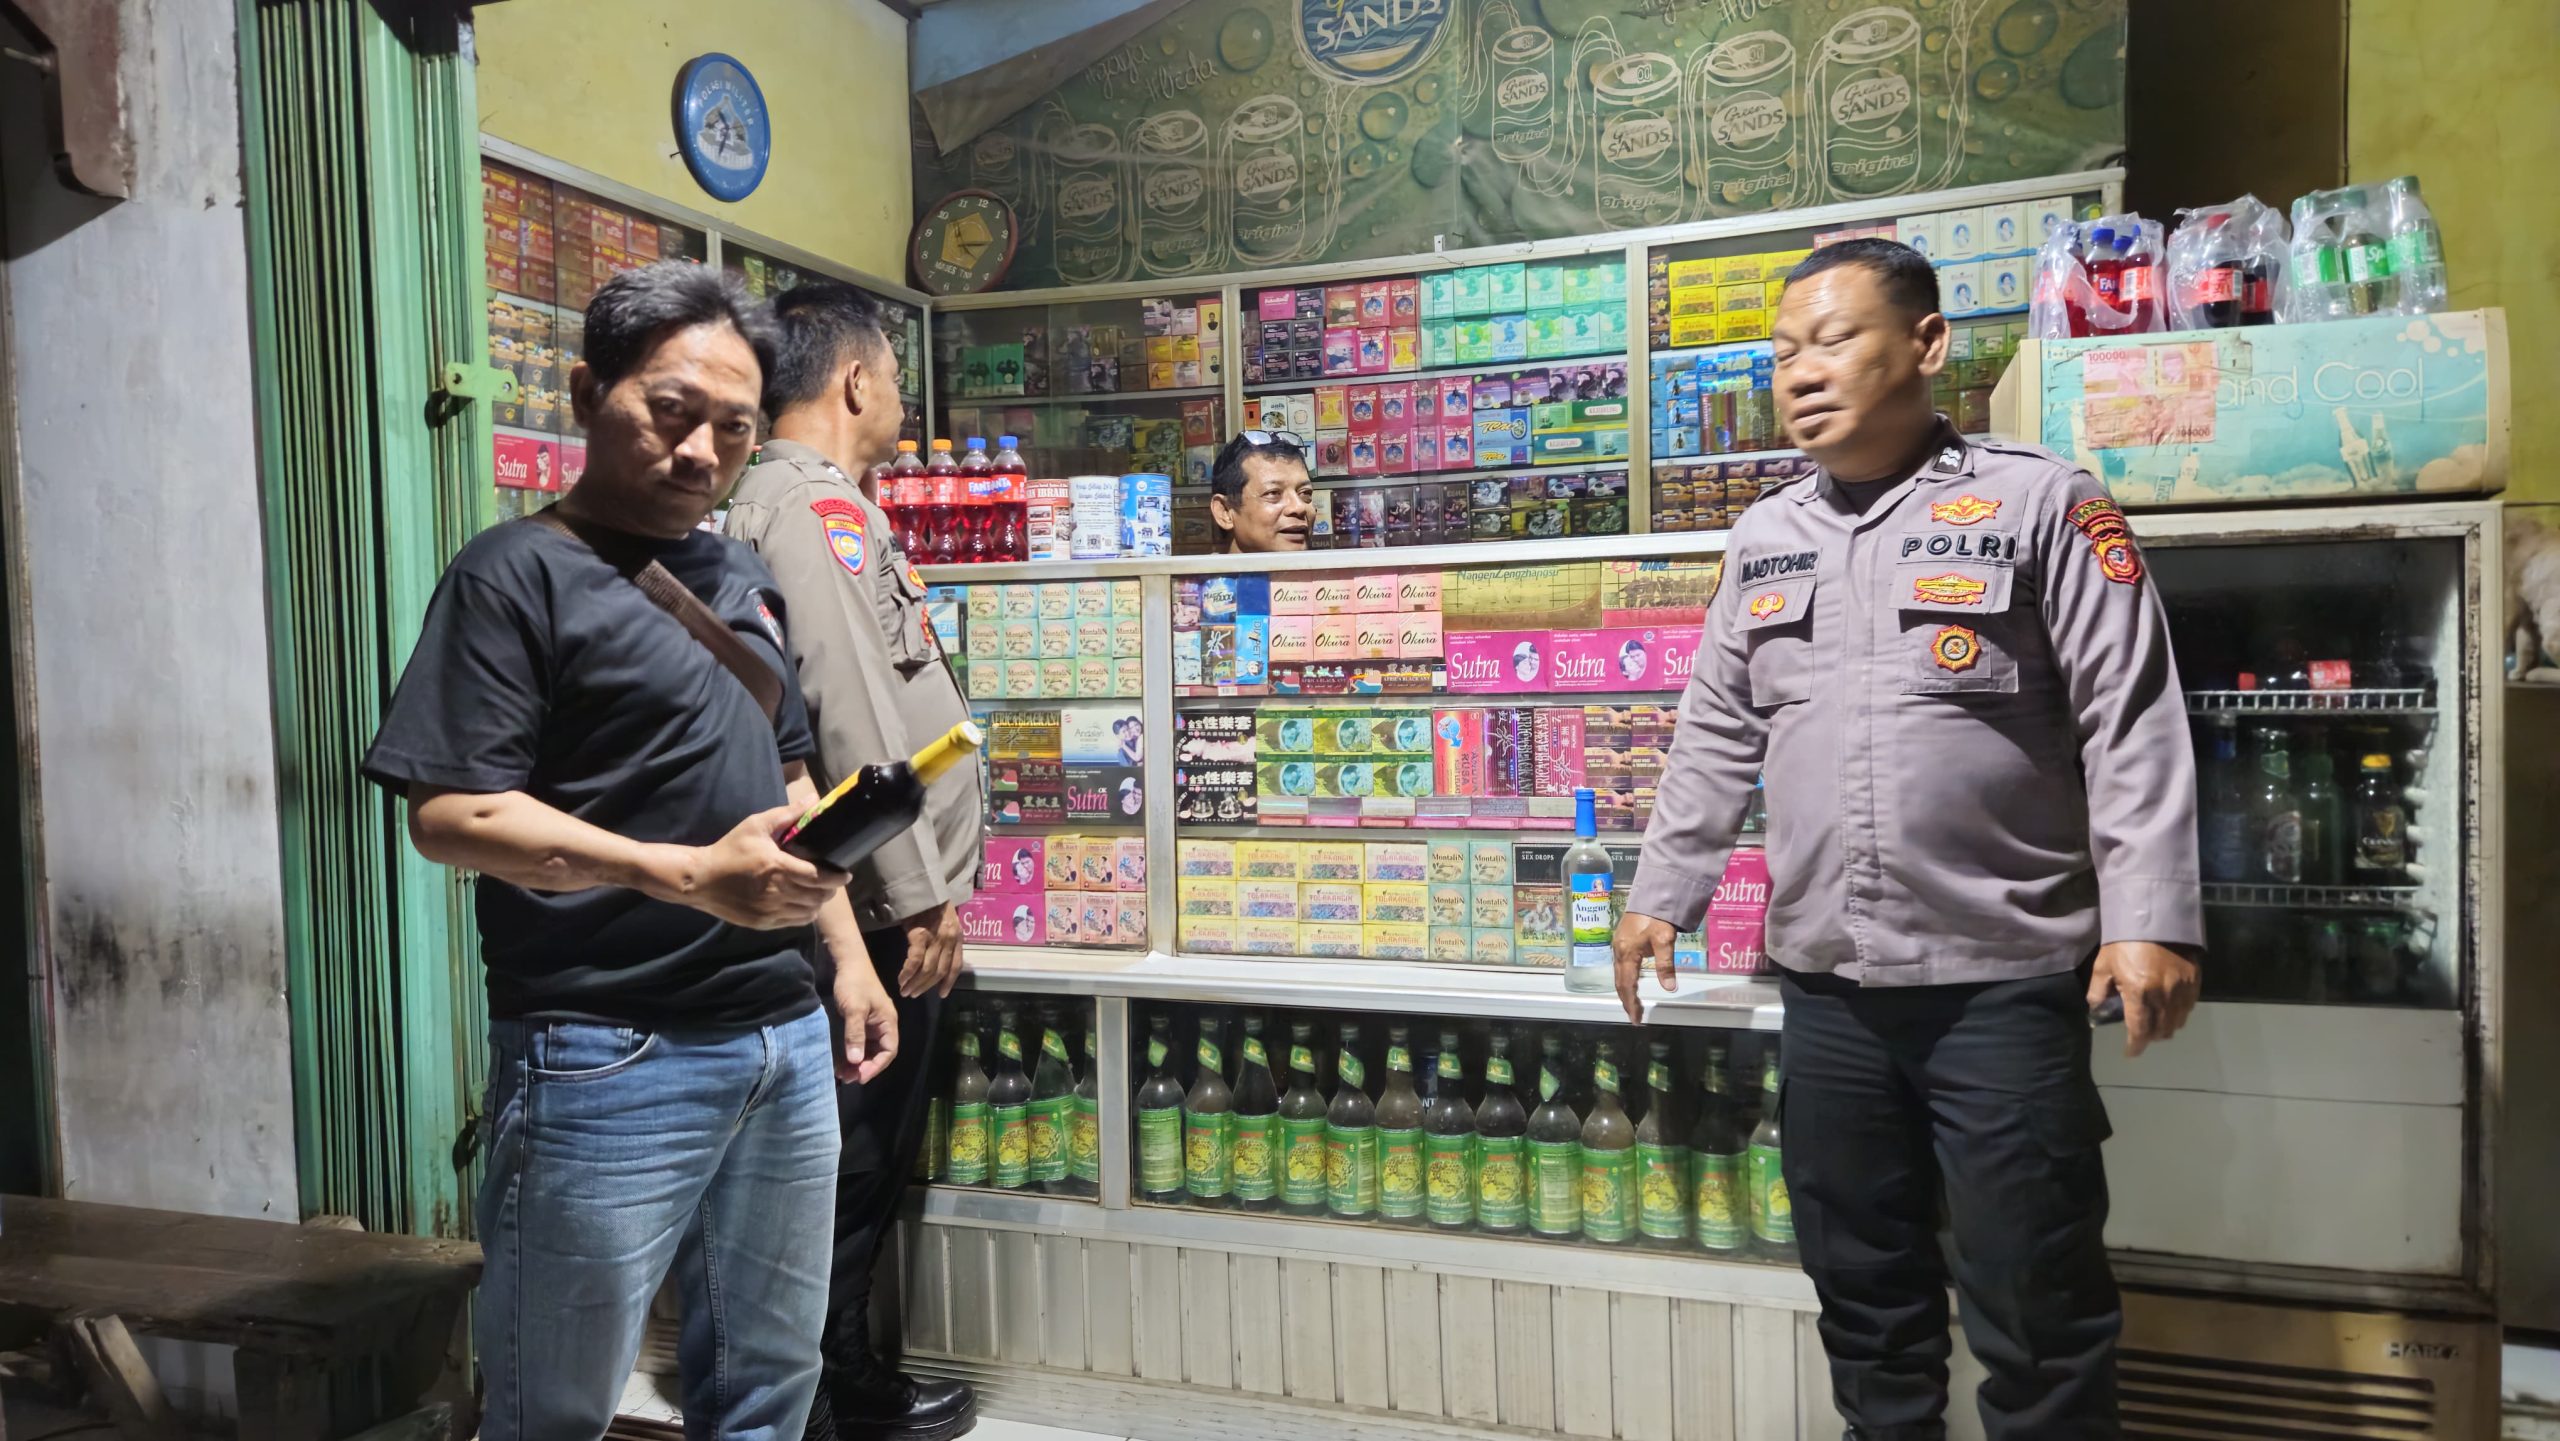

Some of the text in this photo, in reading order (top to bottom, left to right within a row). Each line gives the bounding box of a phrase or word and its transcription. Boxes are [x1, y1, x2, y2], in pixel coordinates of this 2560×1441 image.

[1502, 83, 1546, 104] SANDS
[1838, 87, 1907, 120] SANDS
[1718, 109, 1784, 141] SANDS
[1608, 128, 1670, 157] SANDS
[1241, 167, 1296, 192] SANDS
[1150, 178, 1200, 202] SANDS
[958, 199, 968, 208] 11
[978, 199, 989, 208] 12
[937, 210, 950, 220] 10
[2088, 351, 2127, 362] 100000
[2314, 357, 2424, 401] Cool
[497, 455, 527, 480] Sutra
[968, 482, 992, 493] FANT
[992, 478, 1011, 491] ANTA
[1901, 534, 2017, 560] POLRI
[1741, 551, 1818, 583] MADTOHIR
[1274, 588, 1308, 601] Okura
[1315, 587, 1350, 601] Okura
[1357, 585, 1393, 599] Okura
[1400, 584, 1437, 598] Okura
[1272, 634, 1307, 648] Okura
[1315, 633, 1350, 647] Okura
[1358, 631, 1394, 645] Okura
[1401, 631, 1437, 645] Okura
[1451, 652, 1500, 680] Sutra
[1554, 651, 1604, 679] Sutra
[1067, 786, 1108, 811] Sutra
[1712, 874, 1767, 903] Sutra
[1575, 903, 1607, 913] Anggur
[963, 912, 1003, 937] Sutra
[1575, 913, 1600, 922] Putih
[1720, 942, 1769, 970] Sutra
